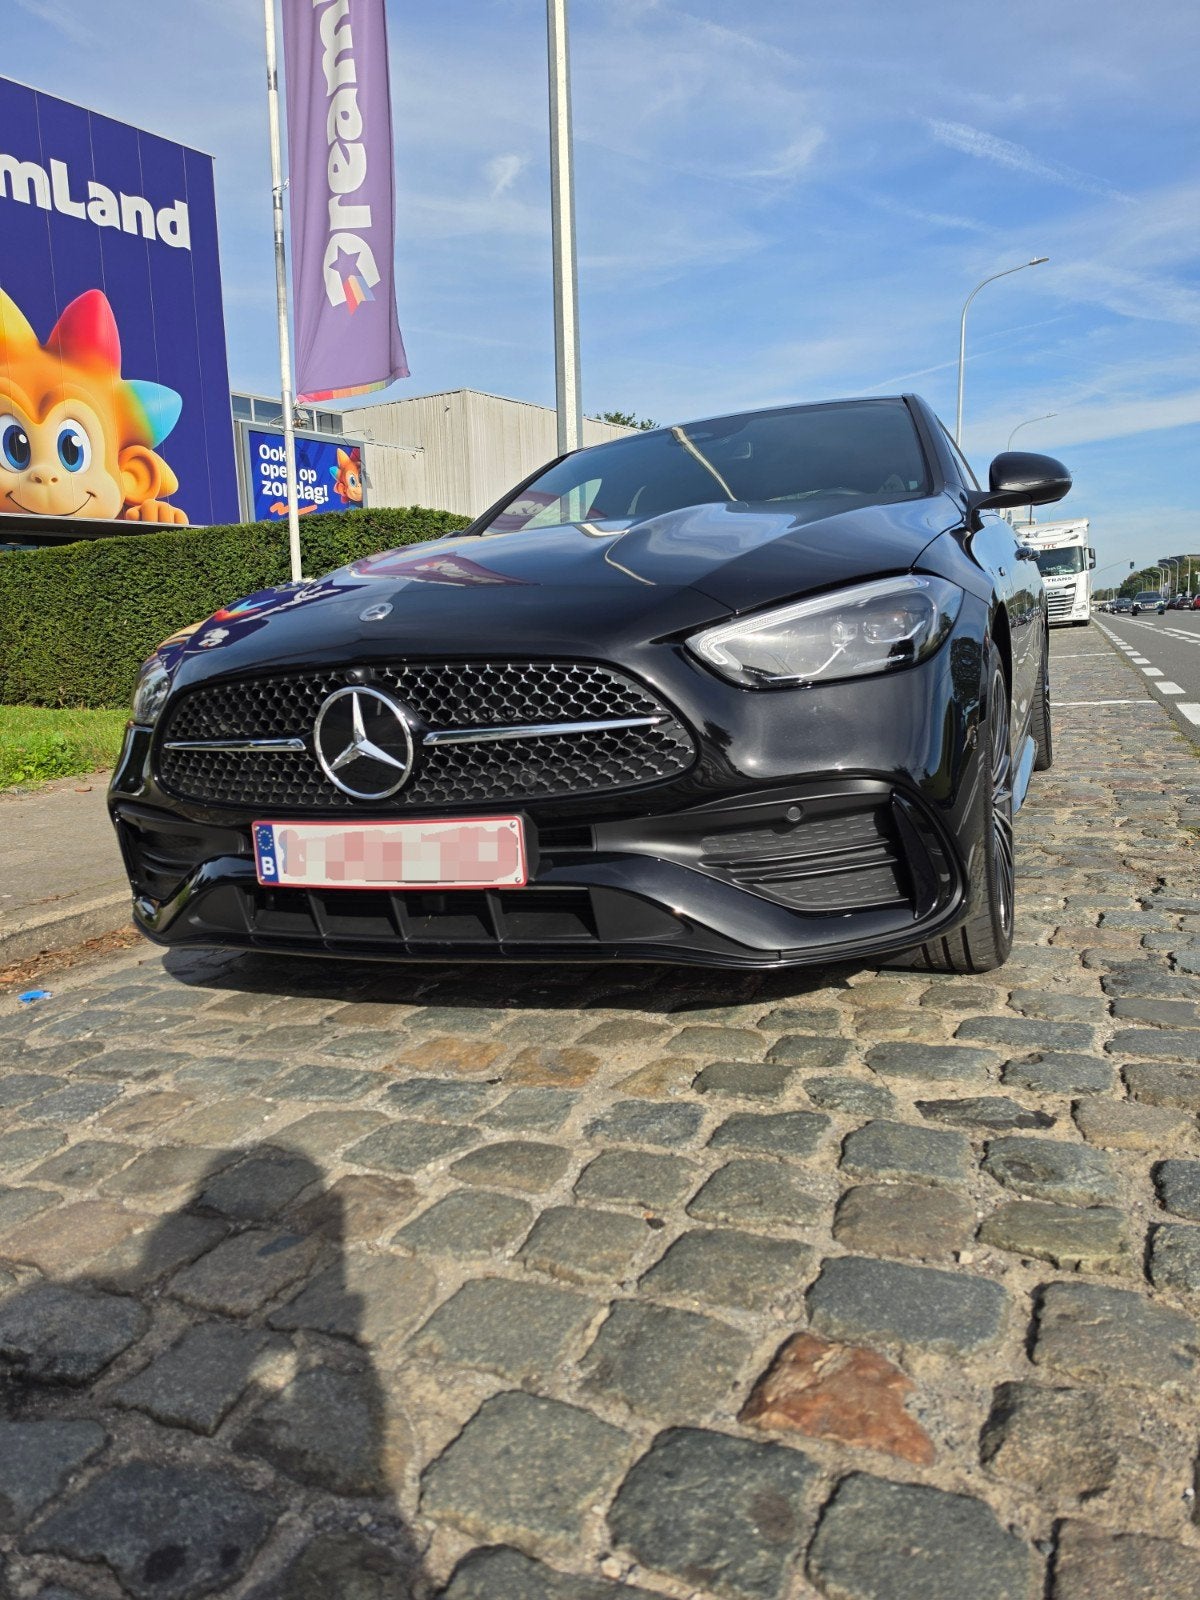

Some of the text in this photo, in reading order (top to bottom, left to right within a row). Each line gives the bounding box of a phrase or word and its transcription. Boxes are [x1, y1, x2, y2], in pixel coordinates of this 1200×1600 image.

[313, 0, 380, 307] Dream
[0, 154, 191, 250] mLand
[259, 444, 287, 462] Ook
[261, 462, 317, 484] ope op
[261, 857, 275, 876] B
